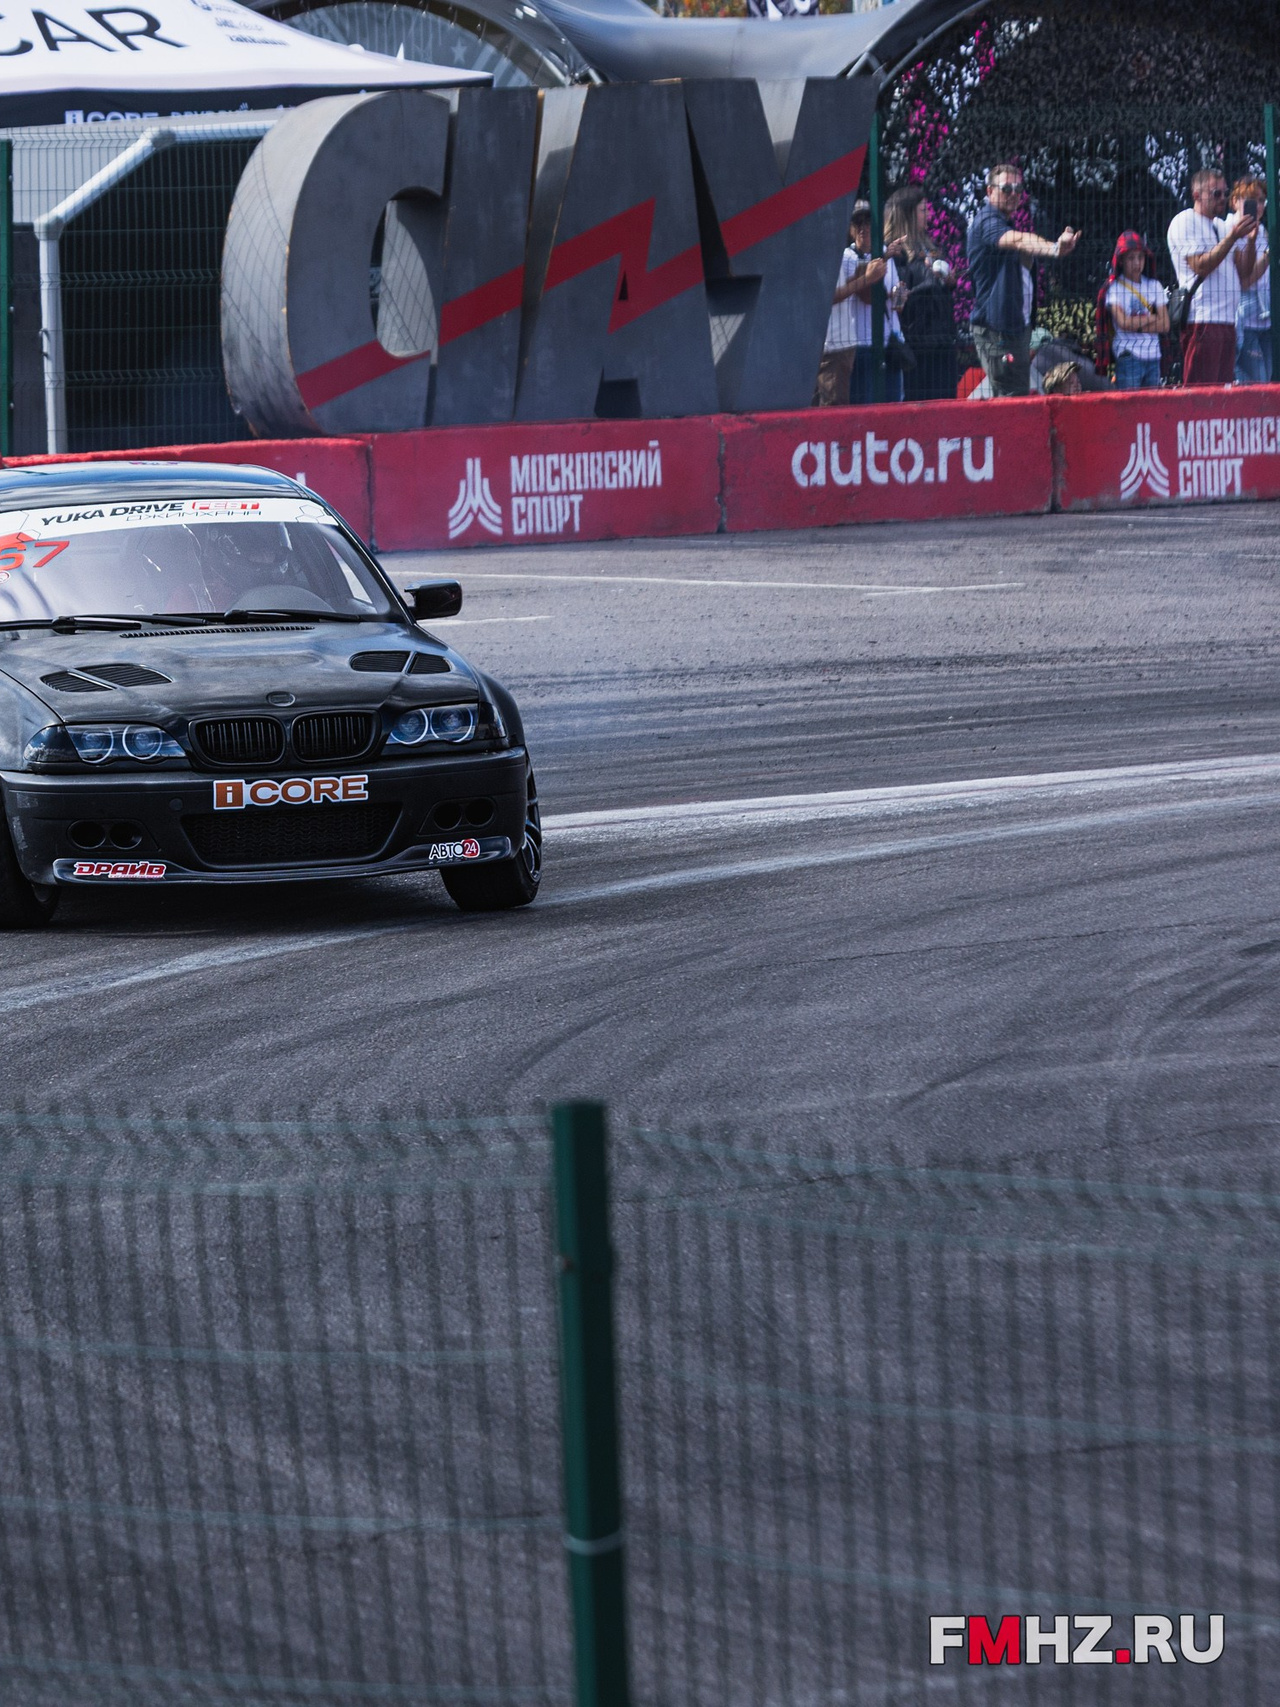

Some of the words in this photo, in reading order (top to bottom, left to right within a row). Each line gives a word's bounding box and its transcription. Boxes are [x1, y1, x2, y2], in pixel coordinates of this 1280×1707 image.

[1177, 416, 1280, 459] МОСКОВС
[510, 440, 663, 493] МОСКОВСКИЙ
[791, 431, 995, 488] auto.ru
[1179, 458, 1244, 498] СПОРТ
[41, 509, 105, 526] YUKA
[109, 502, 185, 517] DRIVE
[510, 493, 584, 536] СПОРТ
[74, 862, 166, 877] ДРАЙВ
